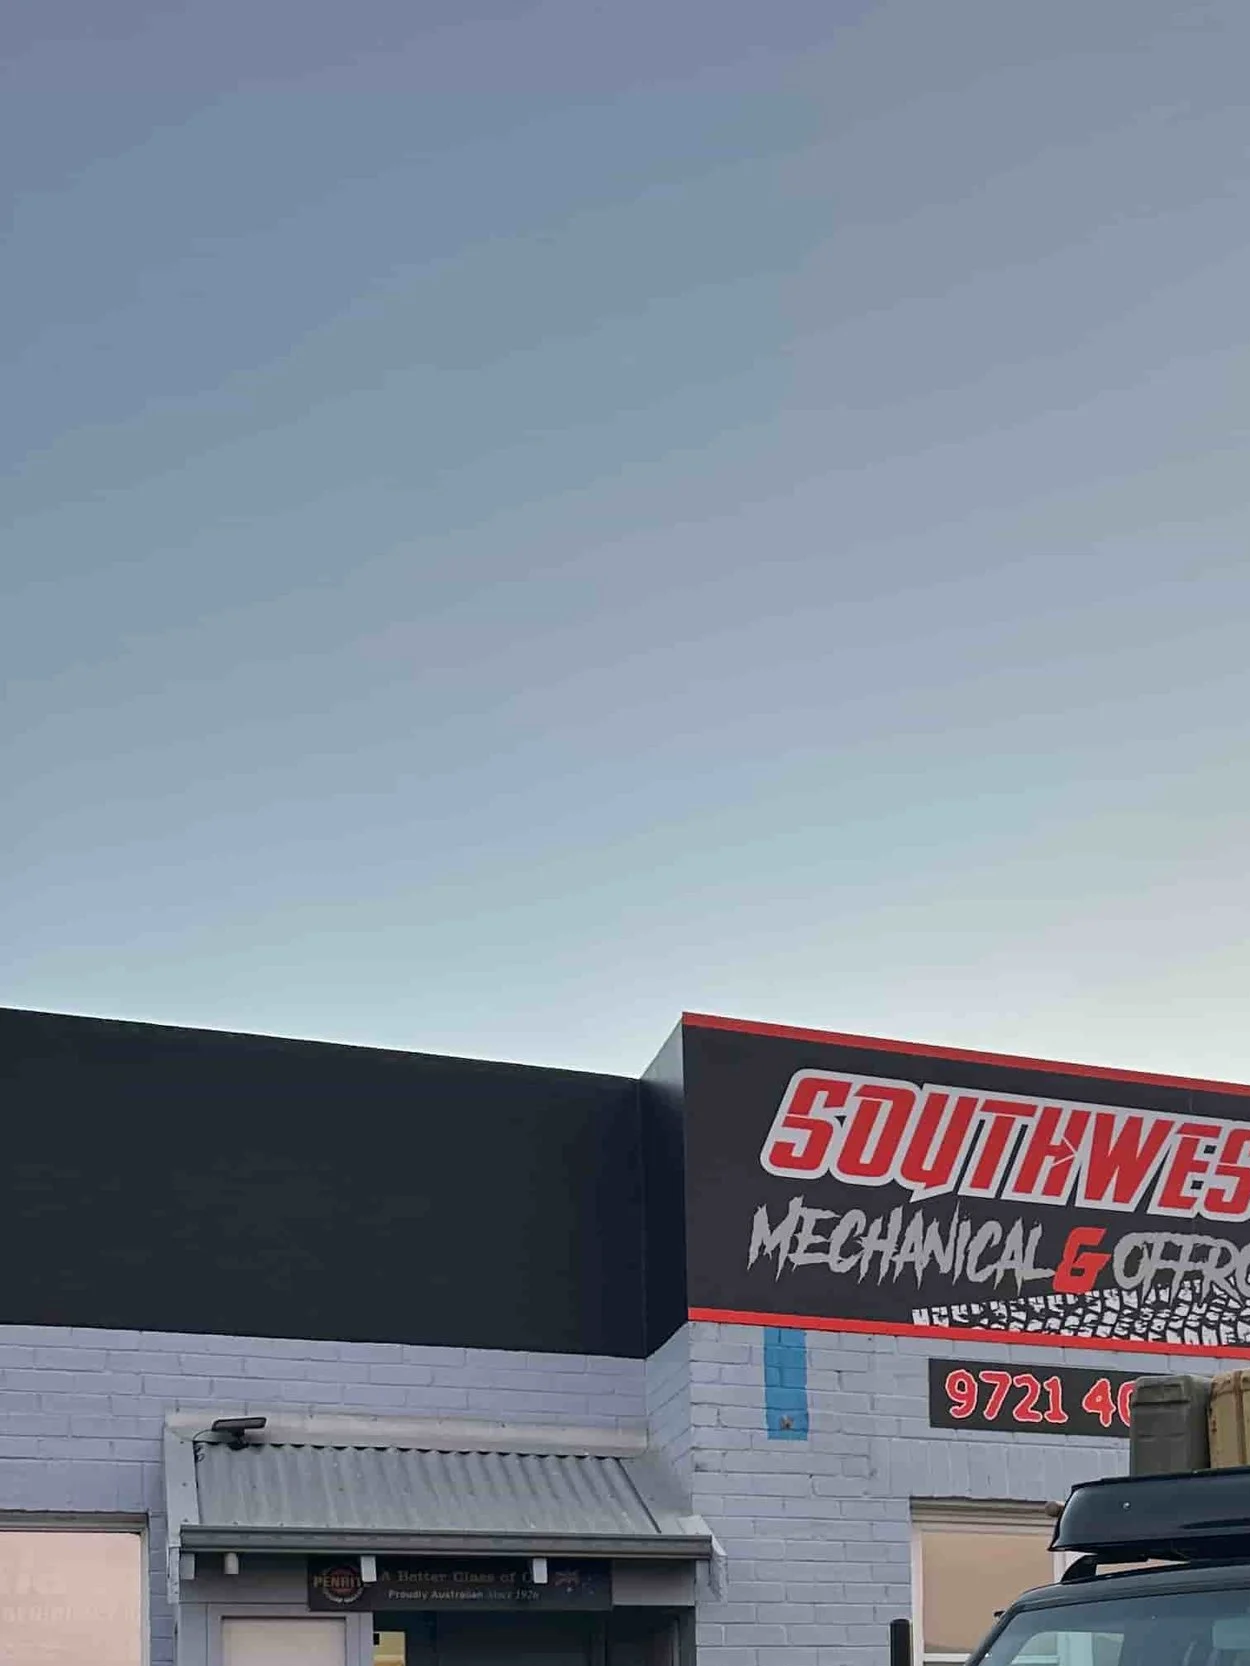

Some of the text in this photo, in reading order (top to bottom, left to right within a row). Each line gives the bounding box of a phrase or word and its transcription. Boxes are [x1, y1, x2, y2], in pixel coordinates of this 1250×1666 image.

[747, 1194, 1054, 1292] MECHANICAL
[945, 1369, 1069, 1424] 9721
[388, 1588, 428, 1601] Proudly
[430, 1588, 484, 1600] Australian
